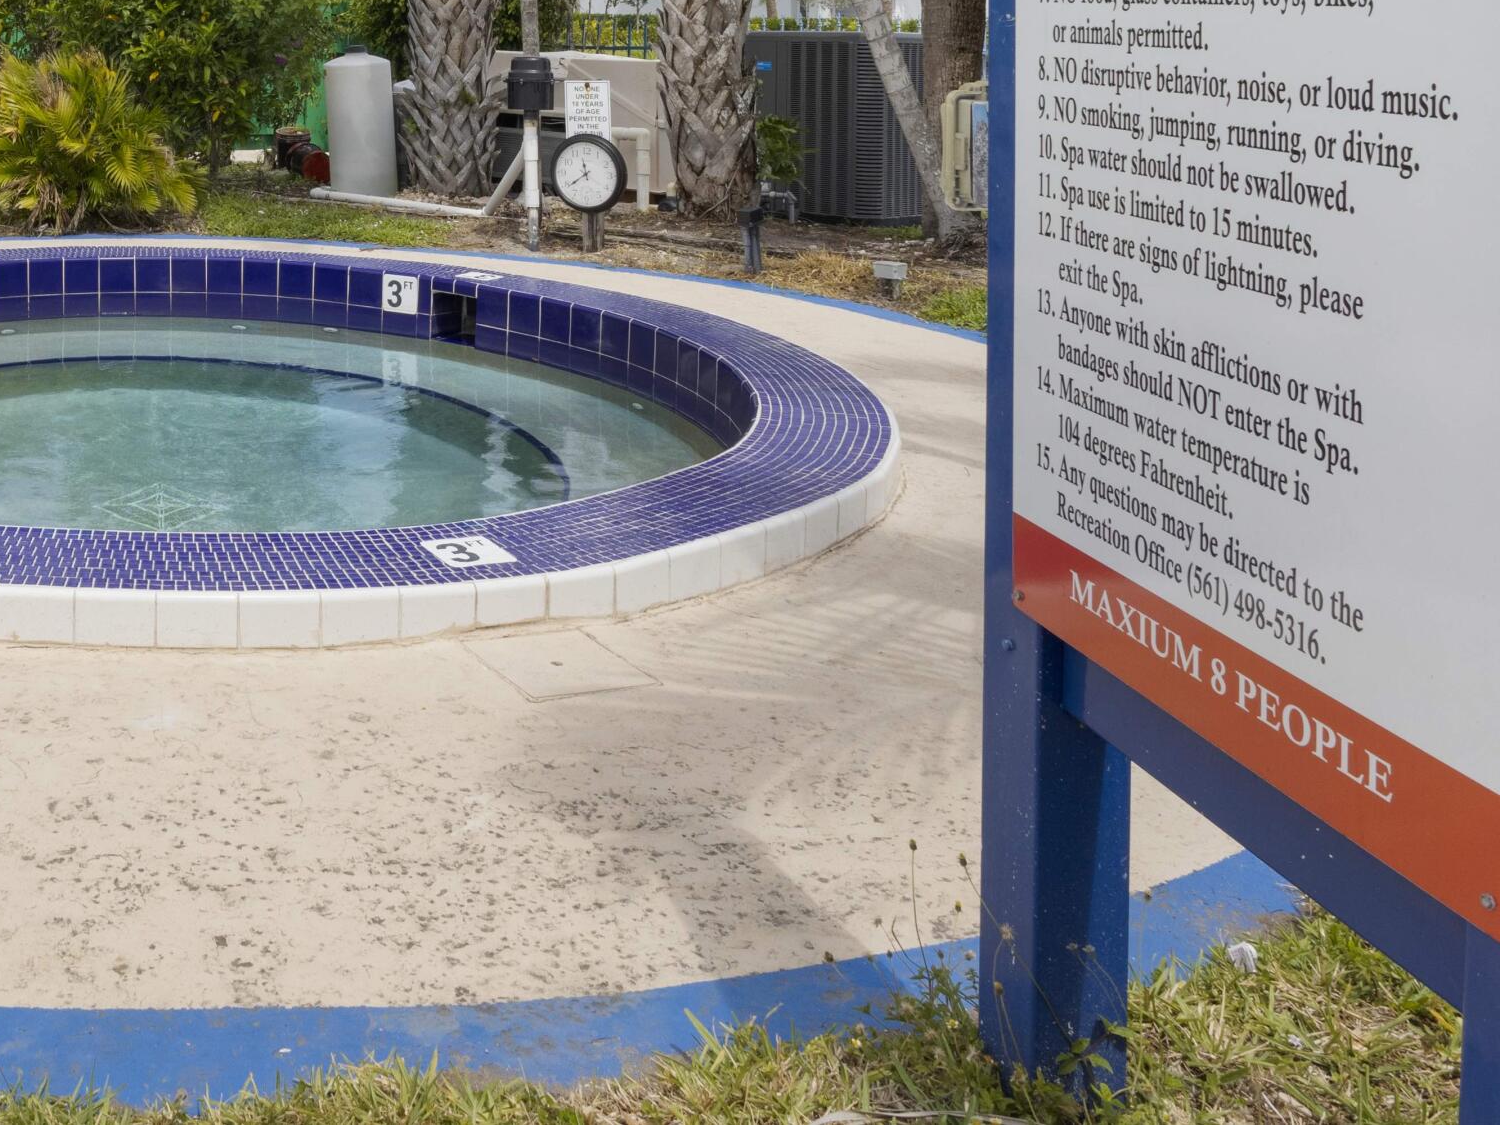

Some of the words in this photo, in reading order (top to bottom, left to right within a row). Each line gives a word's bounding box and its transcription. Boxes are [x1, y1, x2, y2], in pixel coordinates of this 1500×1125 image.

[1052, 23, 1067, 44] or
[1069, 16, 1123, 48] animals
[1126, 18, 1209, 56] permitted.
[1038, 54, 1050, 83] 8.
[1053, 55, 1078, 85] NO
[1080, 57, 1152, 97] disruptive
[1155, 62, 1232, 108] behavior,
[1236, 70, 1292, 115] noise,
[1299, 82, 1322, 109] or
[1325, 75, 1376, 114] loud
[1380, 81, 1459, 122] music.
[1037, 93, 1050, 121] 9.
[1053, 94, 1078, 125] NO
[1080, 101, 1145, 142] smoking,
[1147, 105, 1221, 153] jumping,
[1226, 119, 1307, 166] running,
[1314, 134, 1338, 161] or
[1342, 128, 1420, 181] diving.
[1038, 132, 1057, 162] 10.
[1060, 135, 1085, 172] Spa
[1087, 146, 1128, 174] water
[1130, 146, 1183, 184] should
[1185, 162, 1216, 190] not
[1218, 159, 1240, 195] be
[1244, 169, 1355, 216] swallowed.
[1038, 171, 1057, 201] 11.
[1060, 174, 1085, 212] Spa
[1087, 188, 1111, 213] use
[1113, 185, 1126, 216] is
[1129, 188, 1186, 229] limited
[1188, 204, 1207, 234] to
[1212, 205, 1232, 240] 15
[1235, 212, 1318, 259] minutes.
[387, 280, 402, 308] 3
[403, 280, 414, 290] FT
[1058, 257, 1084, 287] exit
[1086, 262, 1109, 295] the
[1112, 268, 1144, 309] Spa.
[1037, 287, 1056, 319] 13.
[1059, 294, 1112, 338] Anyone
[1114, 315, 1150, 352] with
[1153, 326, 1187, 364] skin
[1190, 339, 1281, 397] afflictions
[1286, 377, 1309, 406] or
[1313, 382, 1364, 426] with
[1037, 364, 1055, 397] 14.
[1058, 372, 1130, 429] Maximum
[1132, 411, 1178, 450] water
[1180, 426, 1289, 497] temperature
[1293, 468, 1310, 507] is
[1057, 332, 1120, 384] bandages
[1122, 358, 1174, 403] should
[1176, 376, 1222, 422] NOT
[1224, 403, 1272, 442] enter
[1276, 415, 1308, 456] the
[1313, 426, 1359, 477] Spa.
[1058, 412, 1081, 449] 104
[1083, 425, 1137, 475] degrees
[1139, 448, 1234, 521] Fahrenheit.
[435, 542, 480, 563] 3
[1056, 489, 1131, 557] Recreation
[1134, 533, 1183, 585] Office
[1186, 561, 1229, 617] (561)
[1233, 587, 1326, 666] 498-5316.
[1069, 569, 1203, 683] MAXIUM
[1210, 657, 1227, 697] 8
[1235, 669, 1393, 804] PEOPLE
